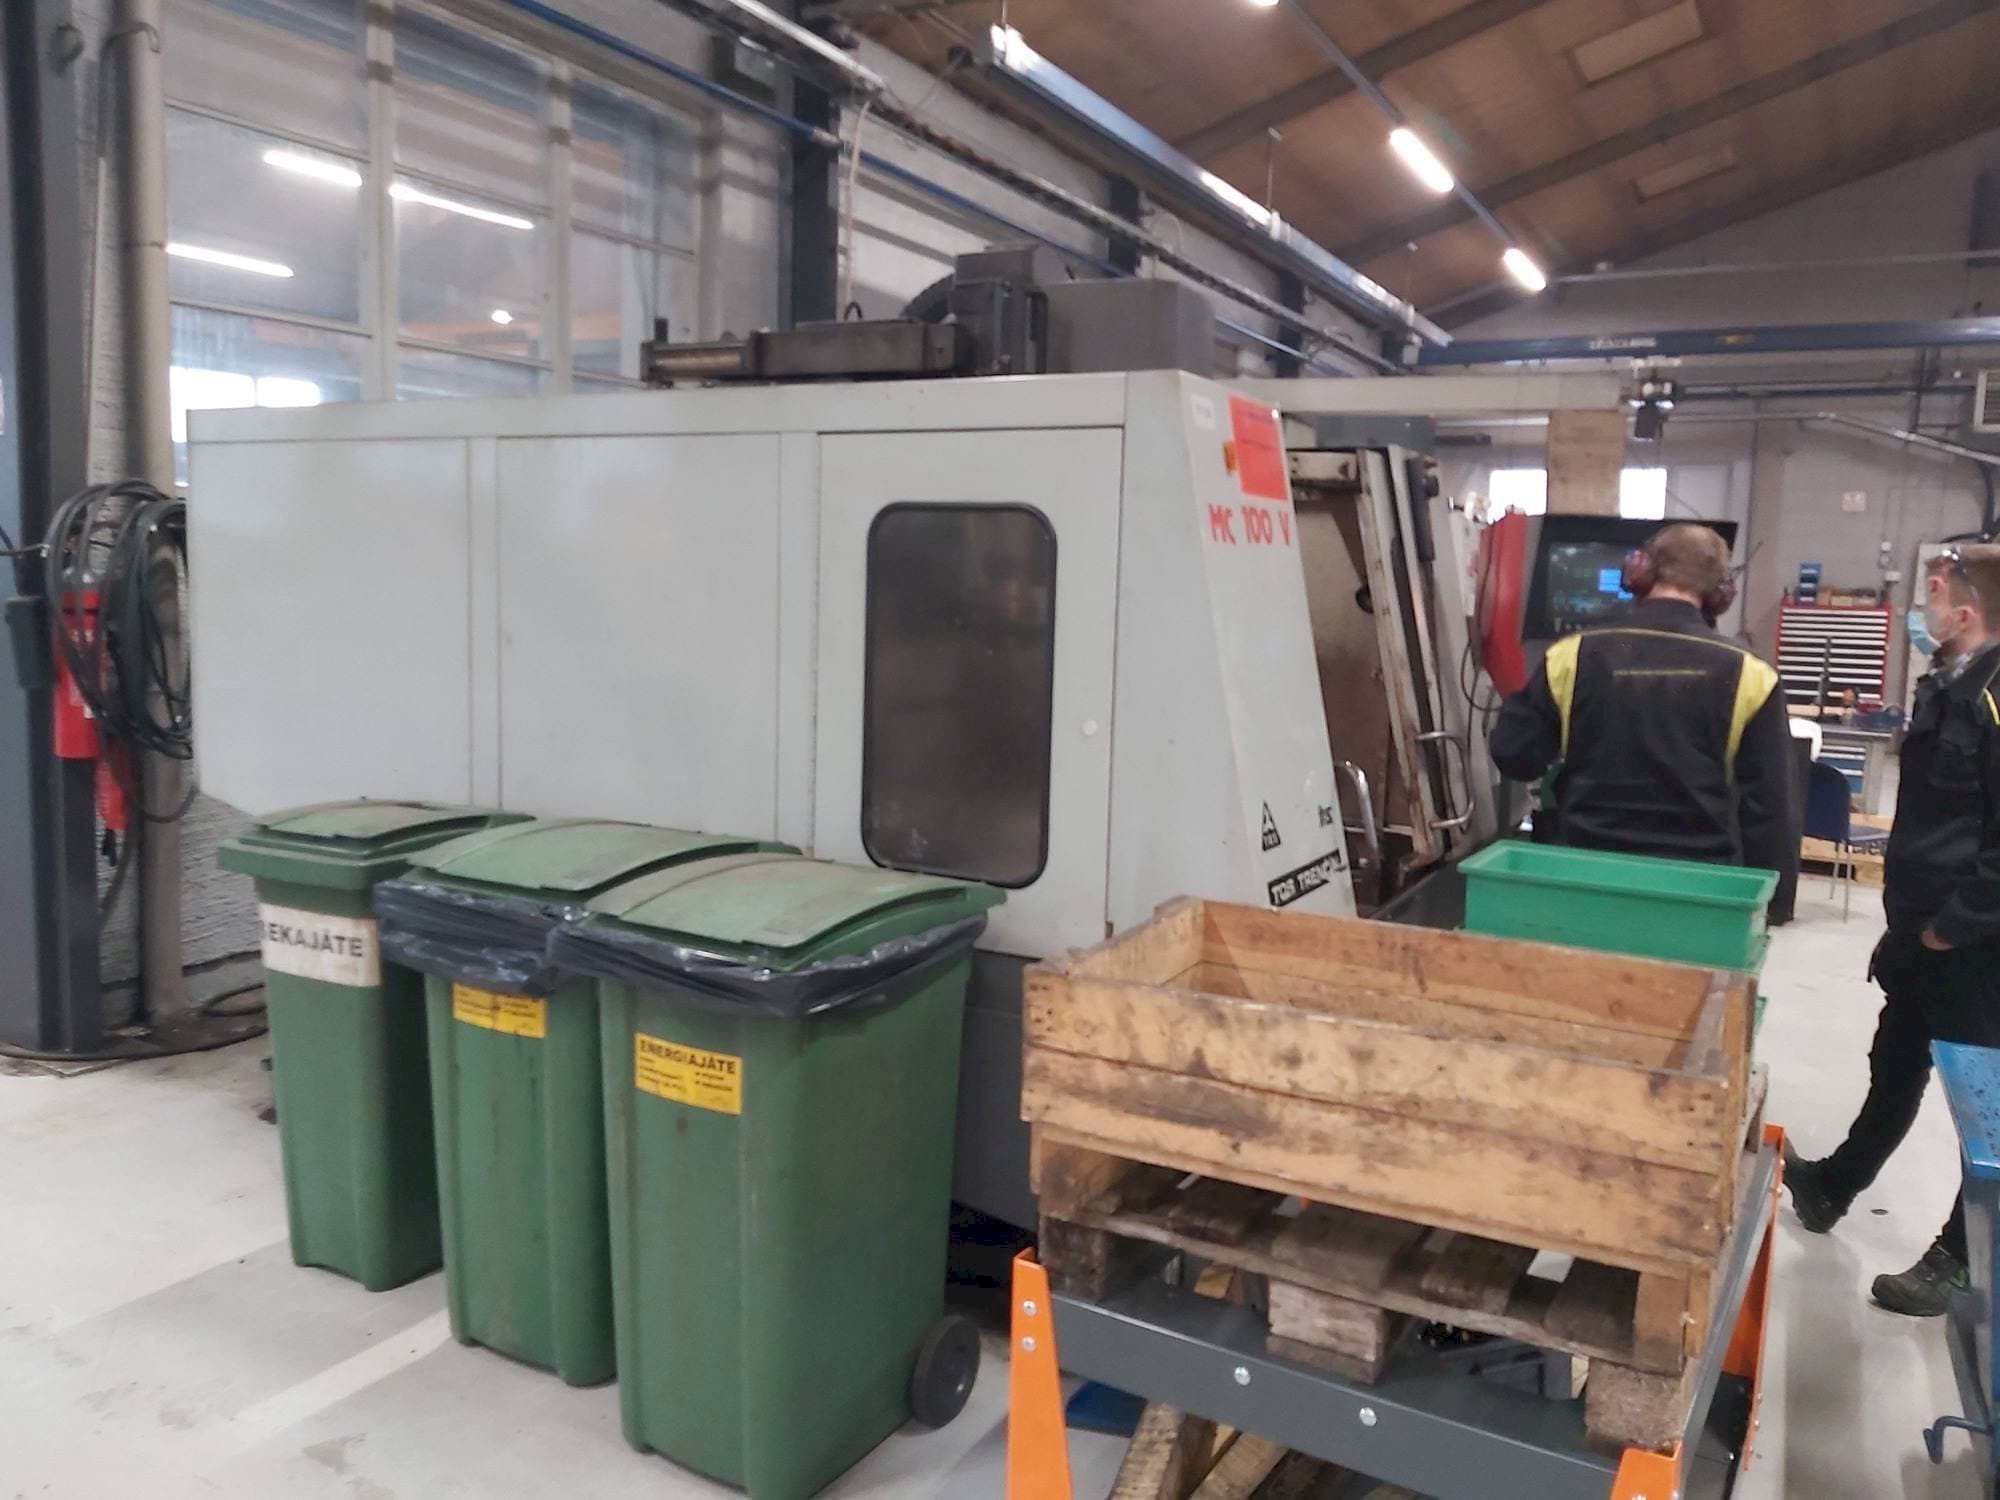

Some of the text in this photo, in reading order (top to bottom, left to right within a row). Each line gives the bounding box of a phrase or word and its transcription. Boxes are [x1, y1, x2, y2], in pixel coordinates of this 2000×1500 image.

[1208, 504, 1290, 546] MC 100 V
[1271, 879, 1295, 904] TOS
[263, 922, 363, 958] EKAJÄTE
[640, 1039, 736, 1074] ENERGIAJÄTE
